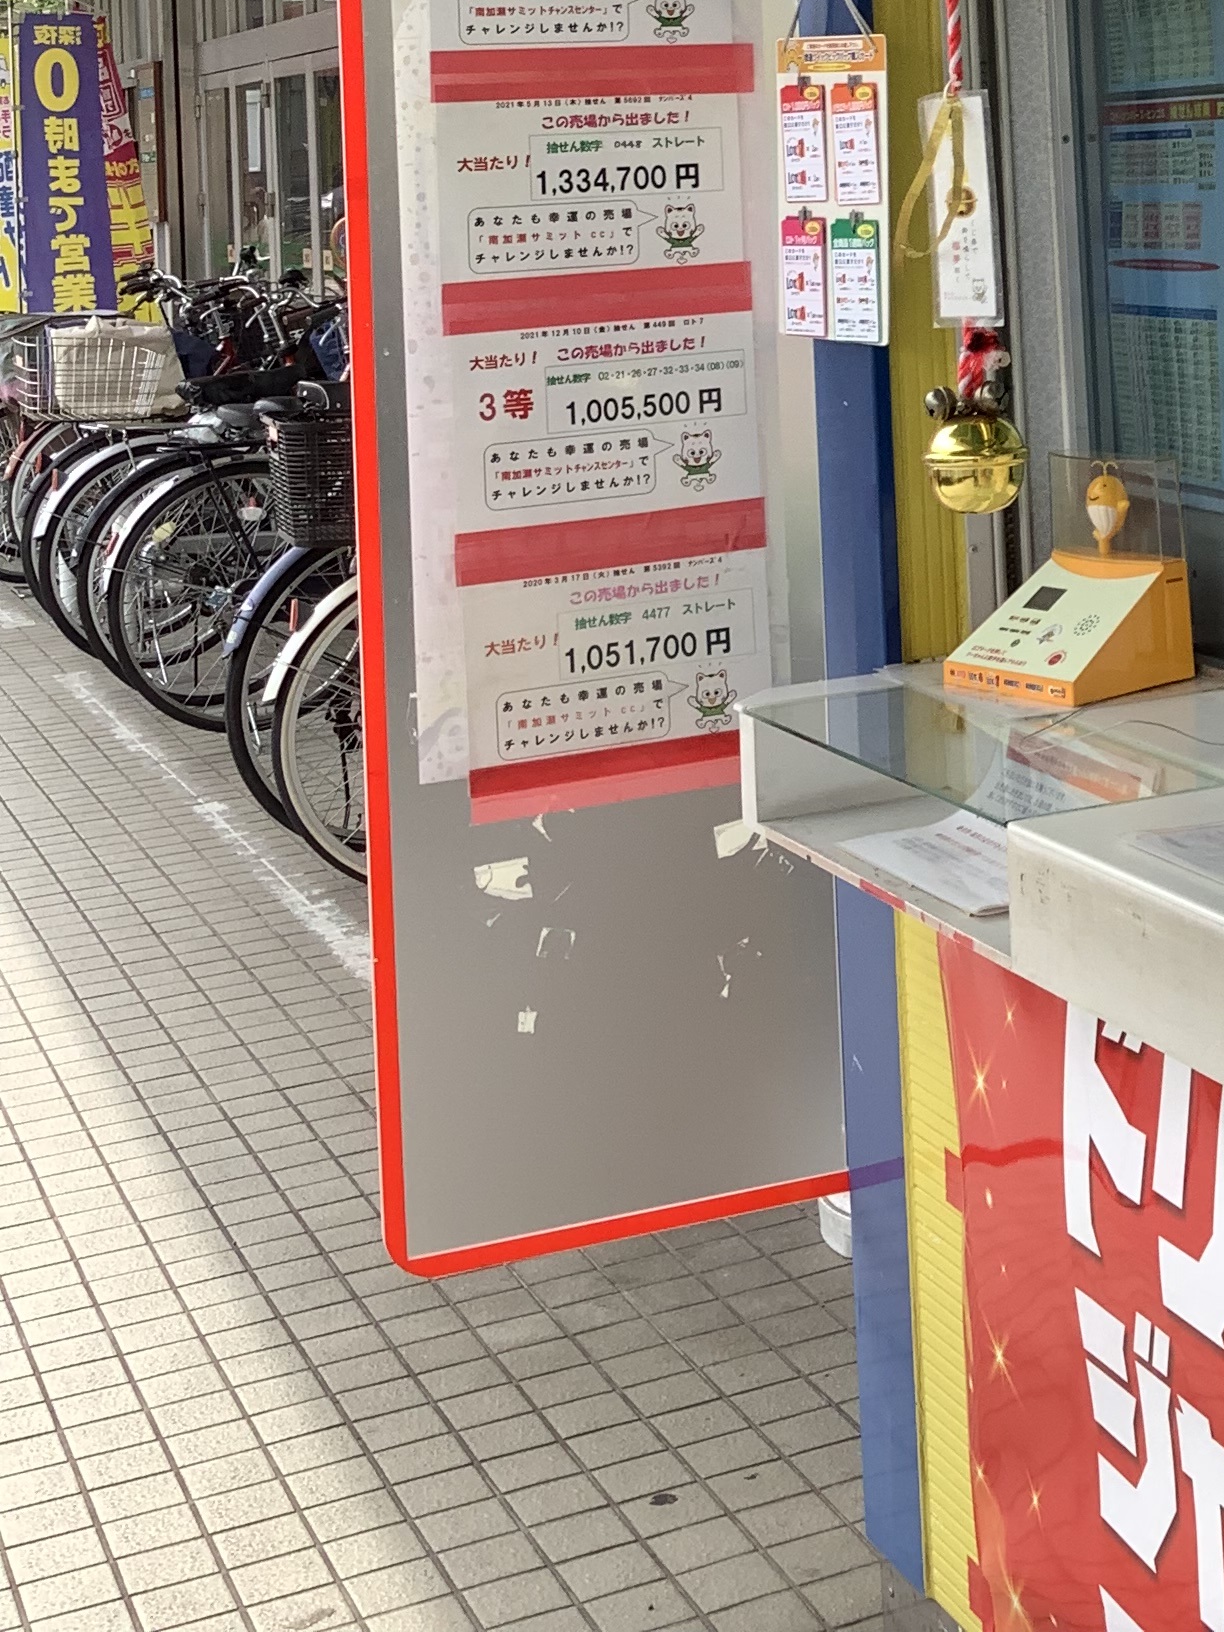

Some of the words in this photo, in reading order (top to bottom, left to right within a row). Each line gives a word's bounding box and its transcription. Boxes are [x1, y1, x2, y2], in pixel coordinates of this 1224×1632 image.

[465, 20, 624, 35] チャレンジしませんか!?
[541, 110, 690, 130] この売場から出ました！
[614, 139, 642, 148] 0448
[653, 135, 705, 148] ストレート
[457, 154, 530, 173] 大当たり！
[536, 163, 700, 196] 1,334,700円
[474, 208, 633, 227] あなたも幸運の売場
[475, 244, 634, 264] チャレンジしませんか!?
[469, 351, 537, 371] 大当たり！
[557, 336, 705, 361] この売場から出ました！
[479, 389, 534, 420] 3等
[566, 388, 722, 425] 1,005,500円
[490, 437, 648, 464] あなたも幸運の売場
[492, 475, 650, 501] チャレンジしませんか!?
[570, 574, 720, 605] この売場から出ました！
[642, 607, 671, 619] 4477
[682, 599, 736, 616] ストレート
[485, 633, 559, 657] 大当たり！
[565, 628, 731, 673] 1,051,700円
[502, 680, 663, 713] あなたも幸運の売場
[504, 717, 665, 751] チャレンジしませんか!?
